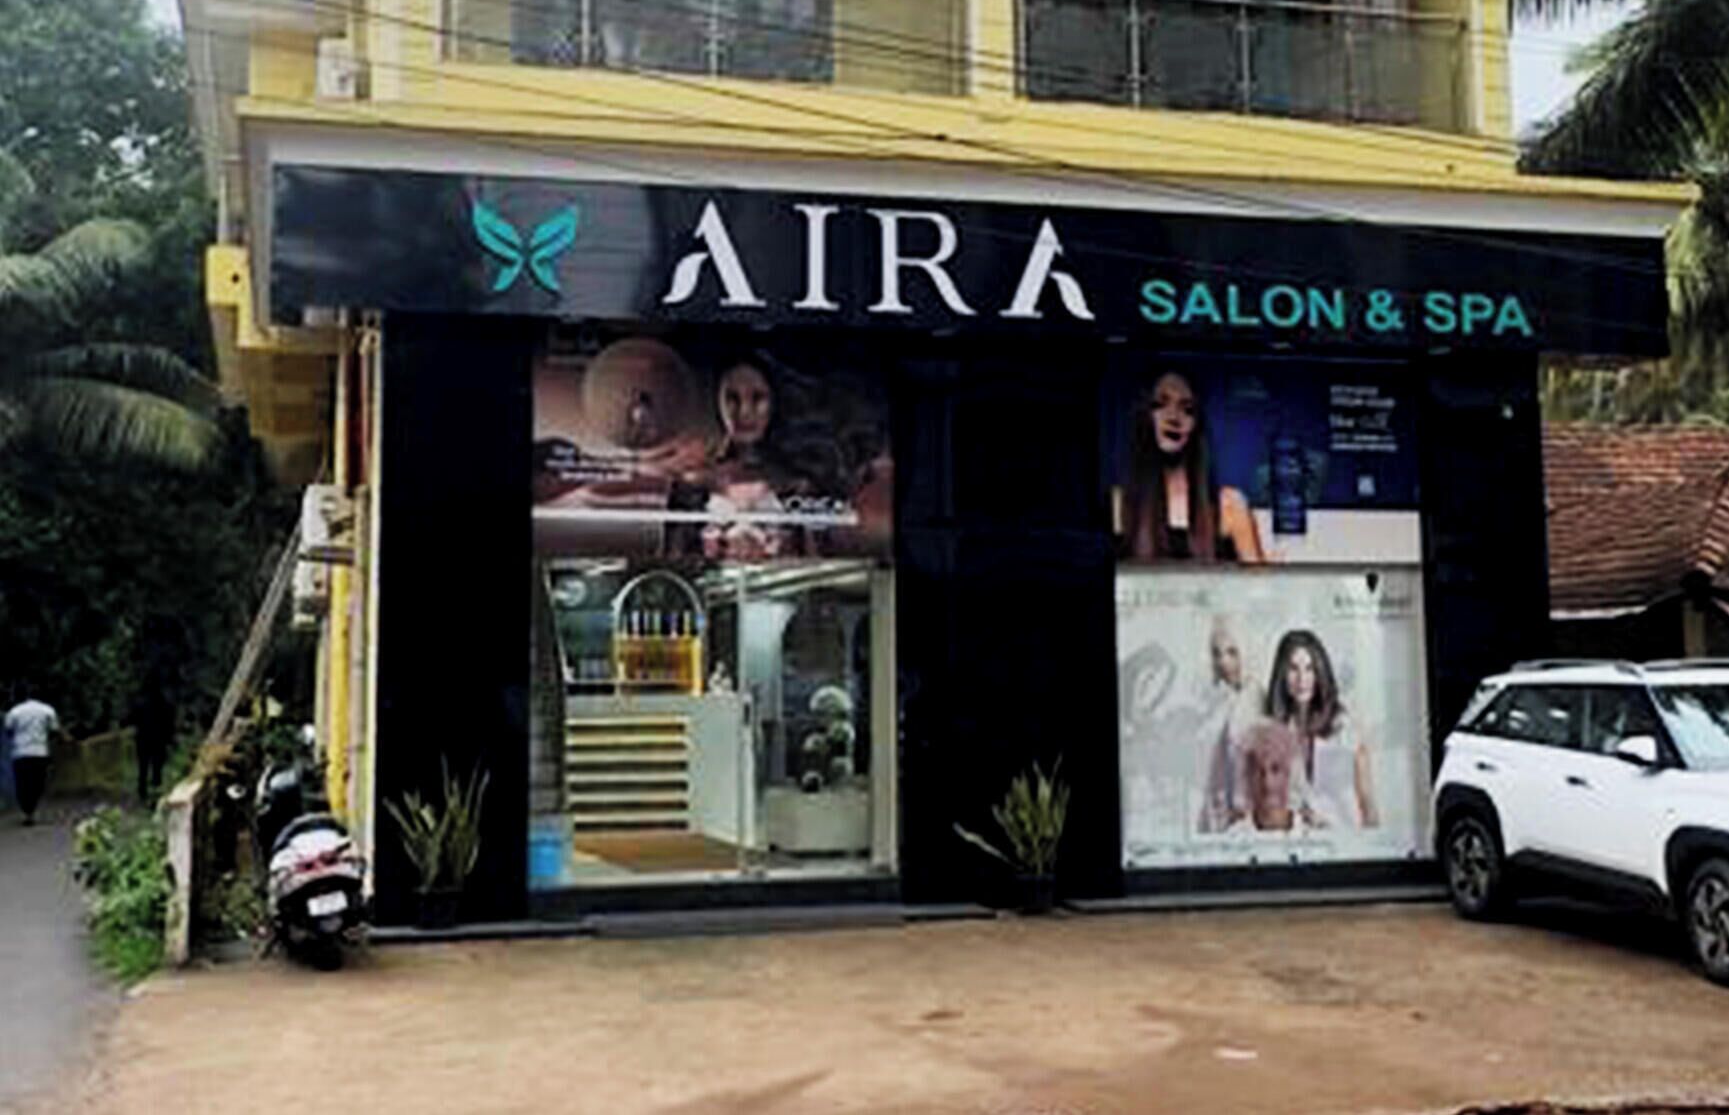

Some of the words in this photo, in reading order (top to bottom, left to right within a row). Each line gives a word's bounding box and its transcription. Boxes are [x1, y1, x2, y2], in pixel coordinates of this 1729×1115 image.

[663, 200, 1095, 321] AIRA
[1139, 279, 1346, 330] SALON
[1364, 289, 1404, 333] &
[1424, 291, 1533, 337] SPA
